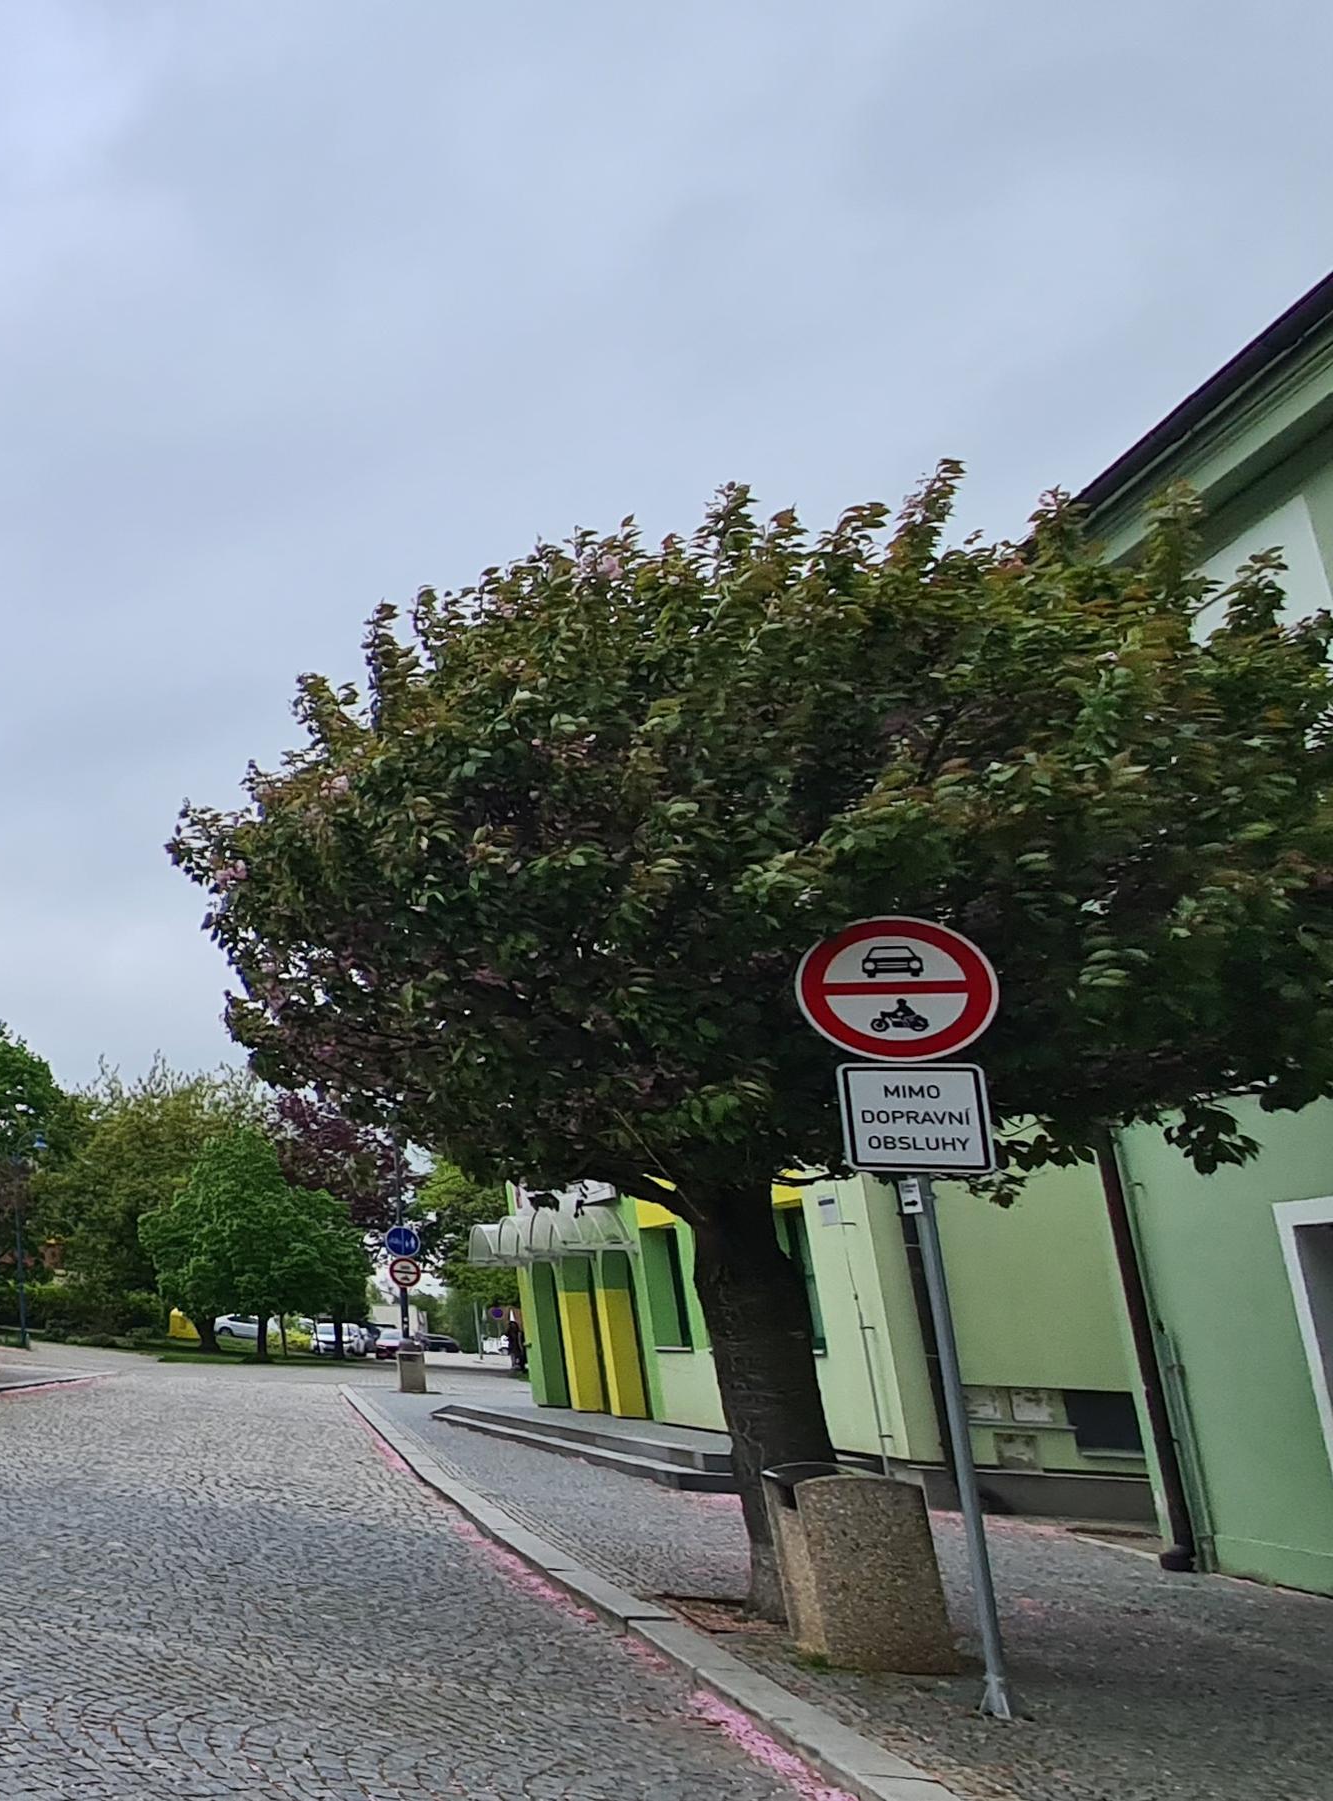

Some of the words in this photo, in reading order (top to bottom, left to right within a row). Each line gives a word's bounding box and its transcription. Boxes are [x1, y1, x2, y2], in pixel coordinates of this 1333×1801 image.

[883, 1084, 941, 1099] MIMO
[861, 1107, 971, 1126] DOPRAVNÍ
[867, 1135, 970, 1152] OBSLUHY
